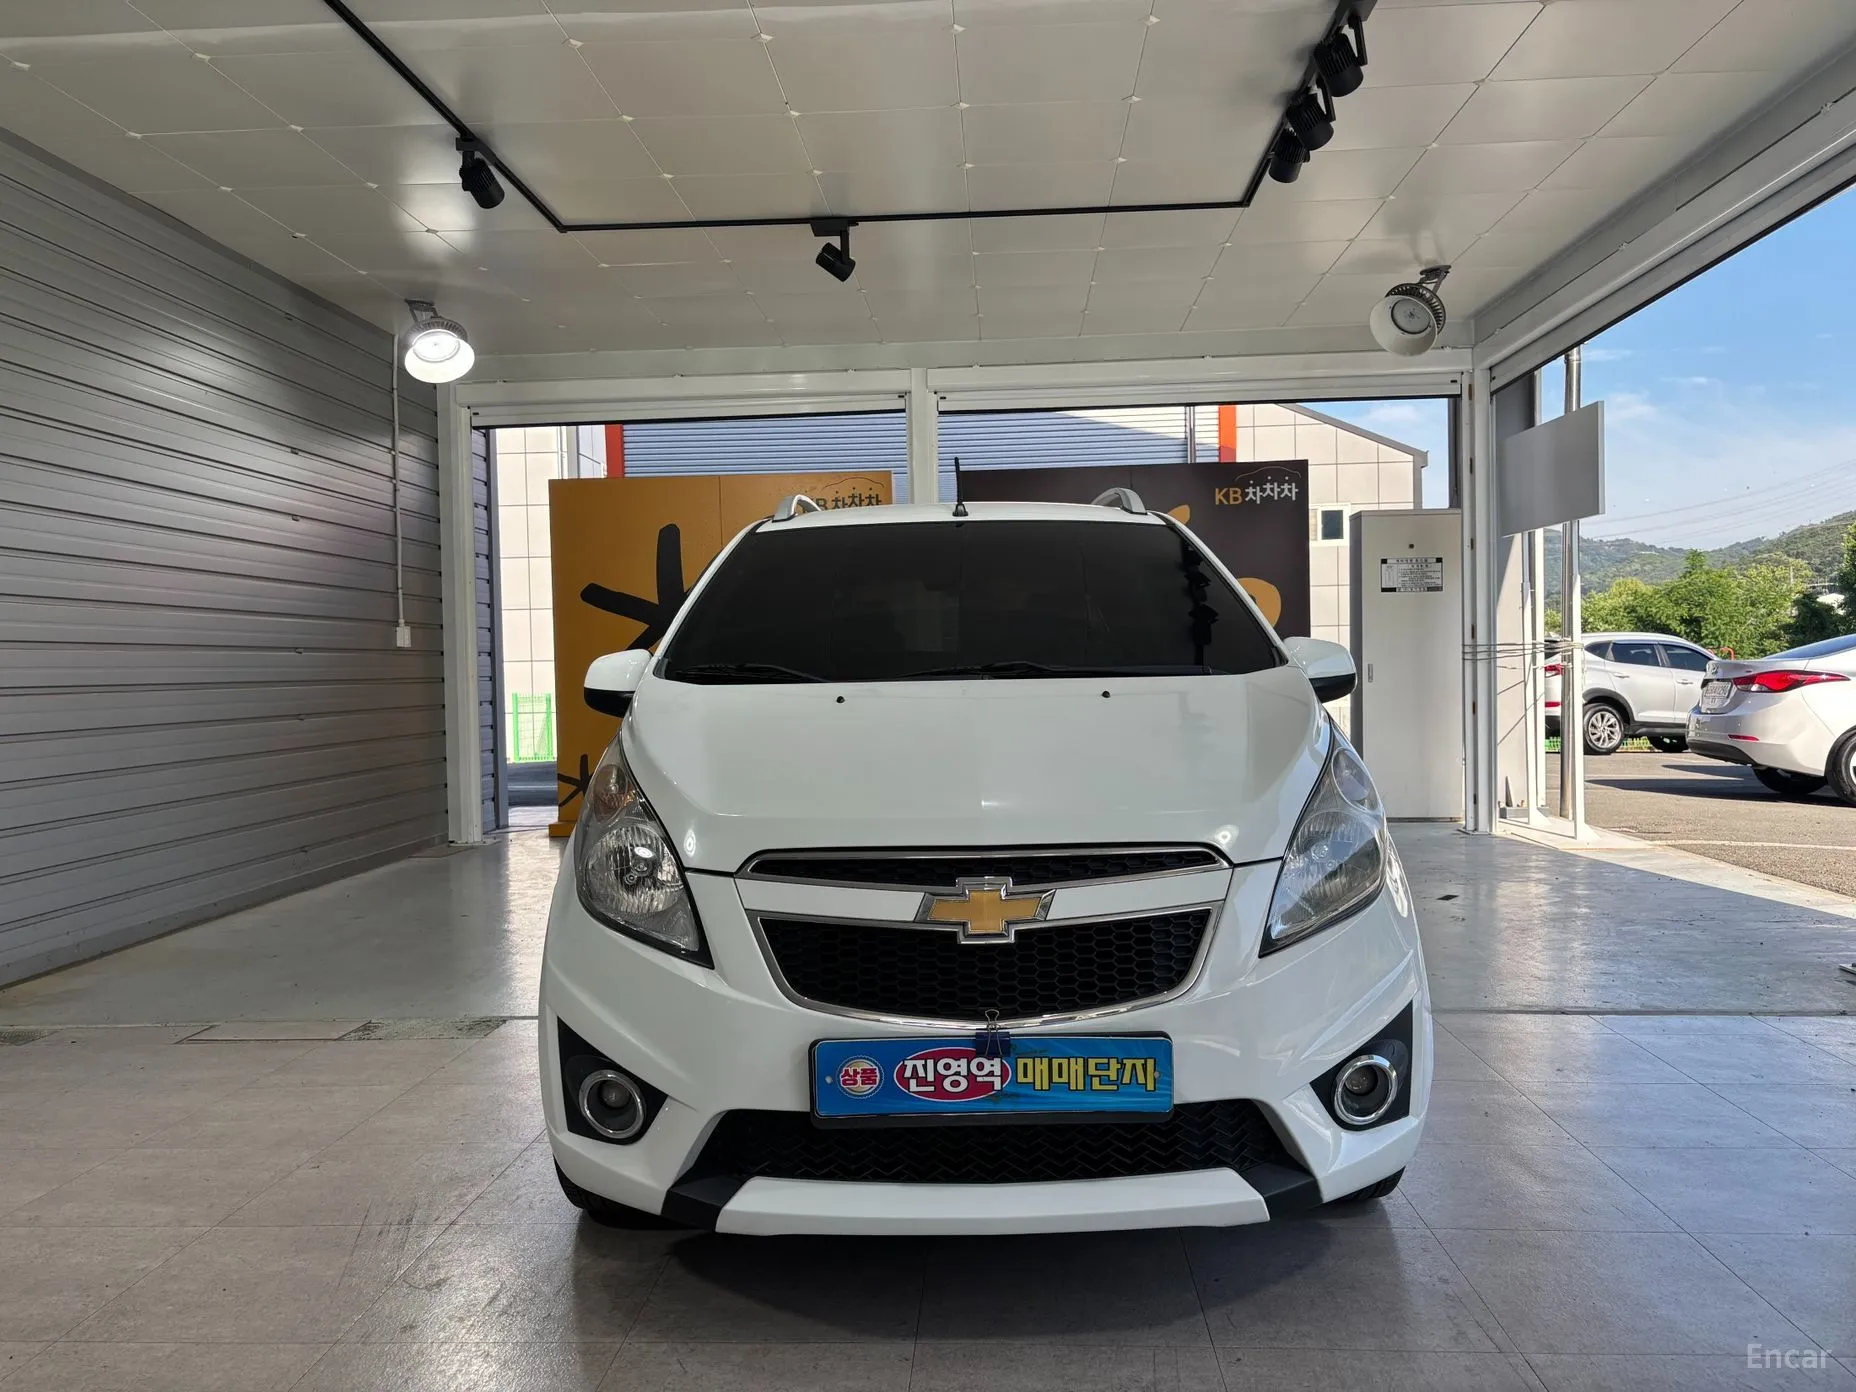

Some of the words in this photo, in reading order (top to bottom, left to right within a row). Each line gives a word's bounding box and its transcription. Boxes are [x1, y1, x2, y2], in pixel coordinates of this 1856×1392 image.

[832, 486, 882, 509] 차차차
[1215, 487, 1242, 505] KB
[1245, 476, 1299, 504] 차차차
[840, 1066, 878, 1088] 상품
[903, 1056, 1003, 1094] 진영역
[1015, 1056, 1157, 1092] 매매단지
